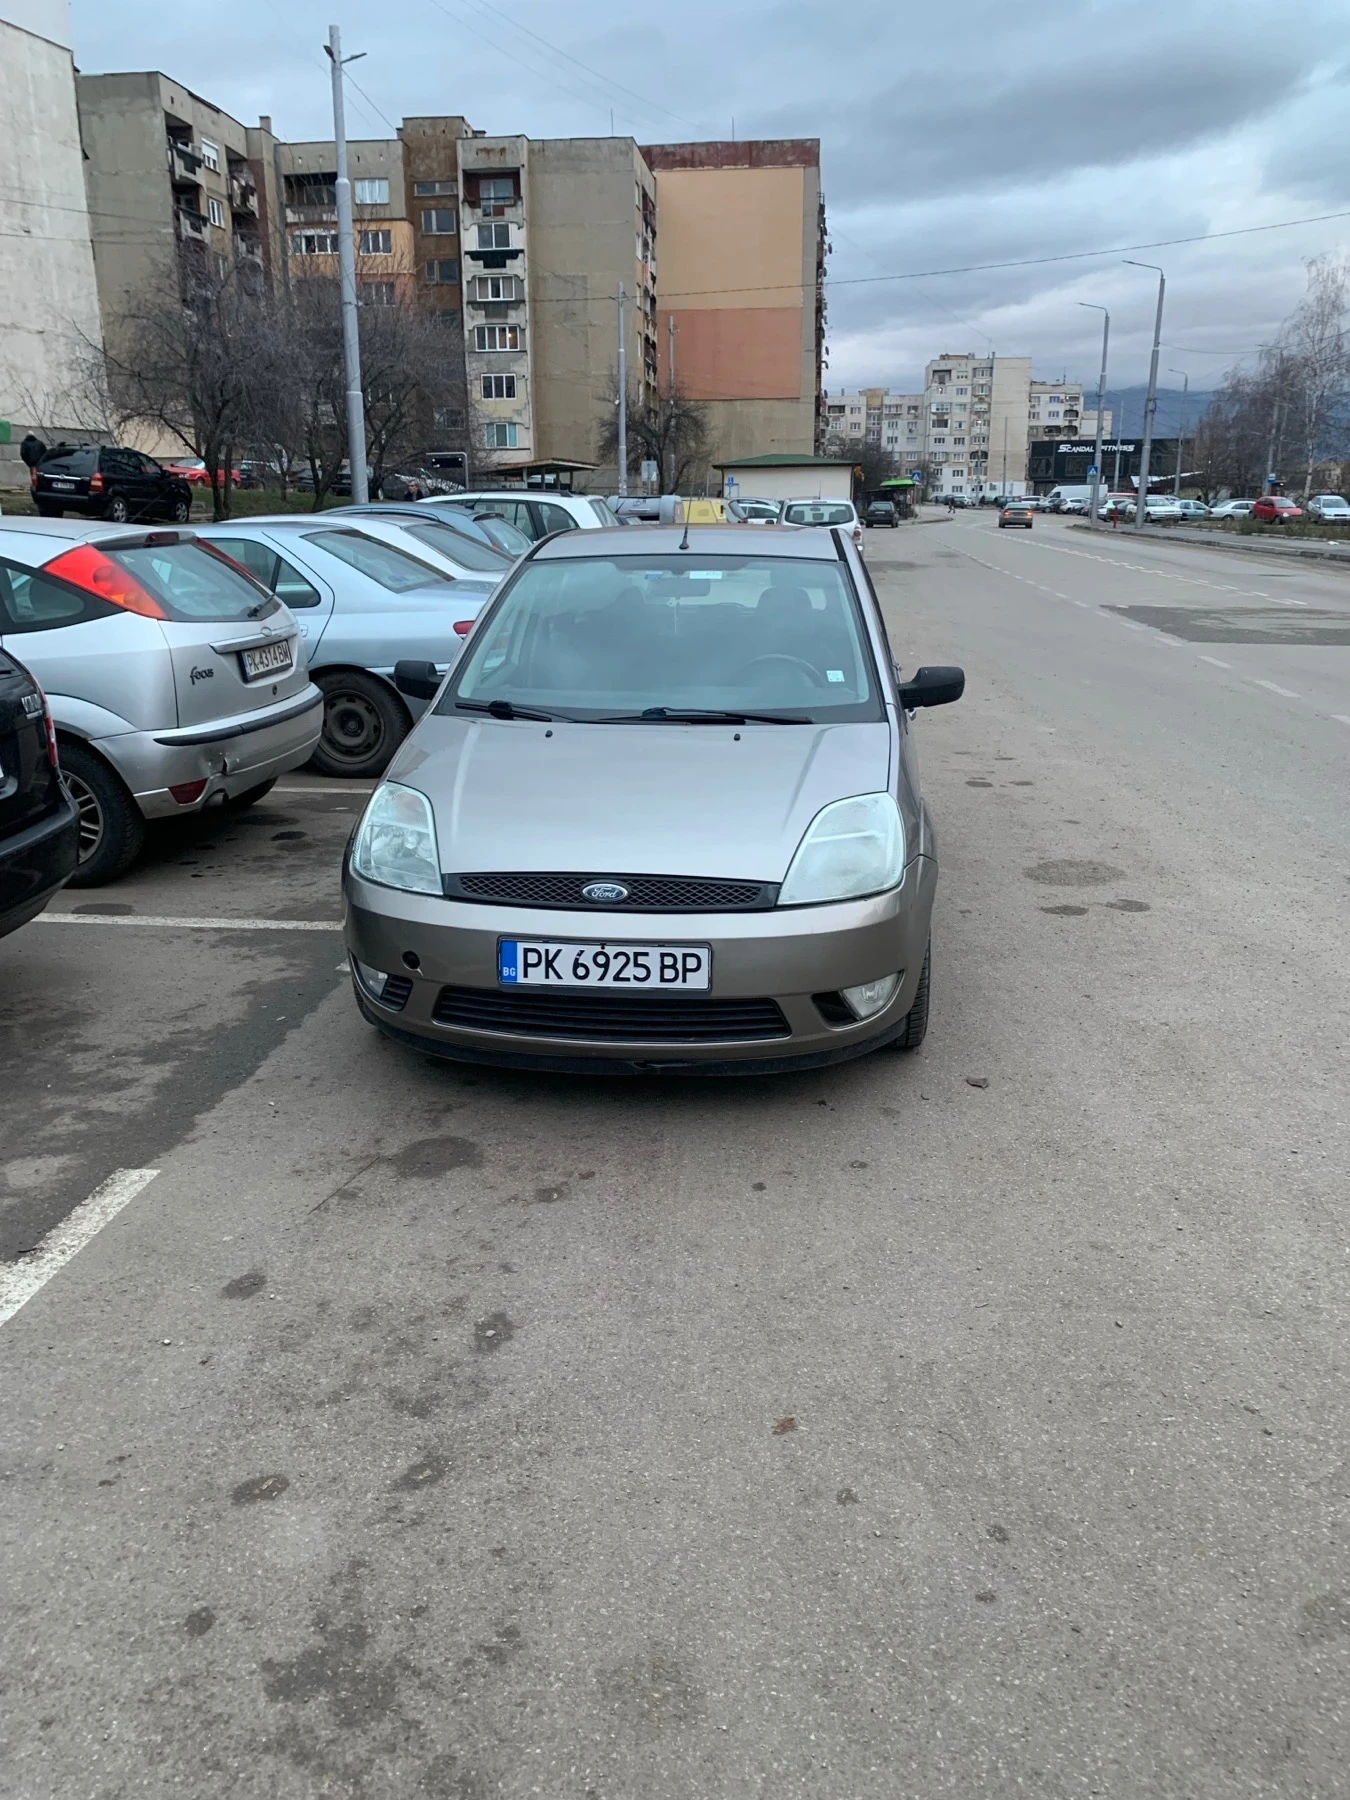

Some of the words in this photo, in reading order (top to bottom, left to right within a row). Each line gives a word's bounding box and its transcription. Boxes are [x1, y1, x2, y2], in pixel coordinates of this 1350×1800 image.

[1057, 444, 1095, 453] SCANDAL
[591, 886, 618, 898] Ford
[503, 966, 516, 976] BG
[572, 949, 652, 983] 6925
